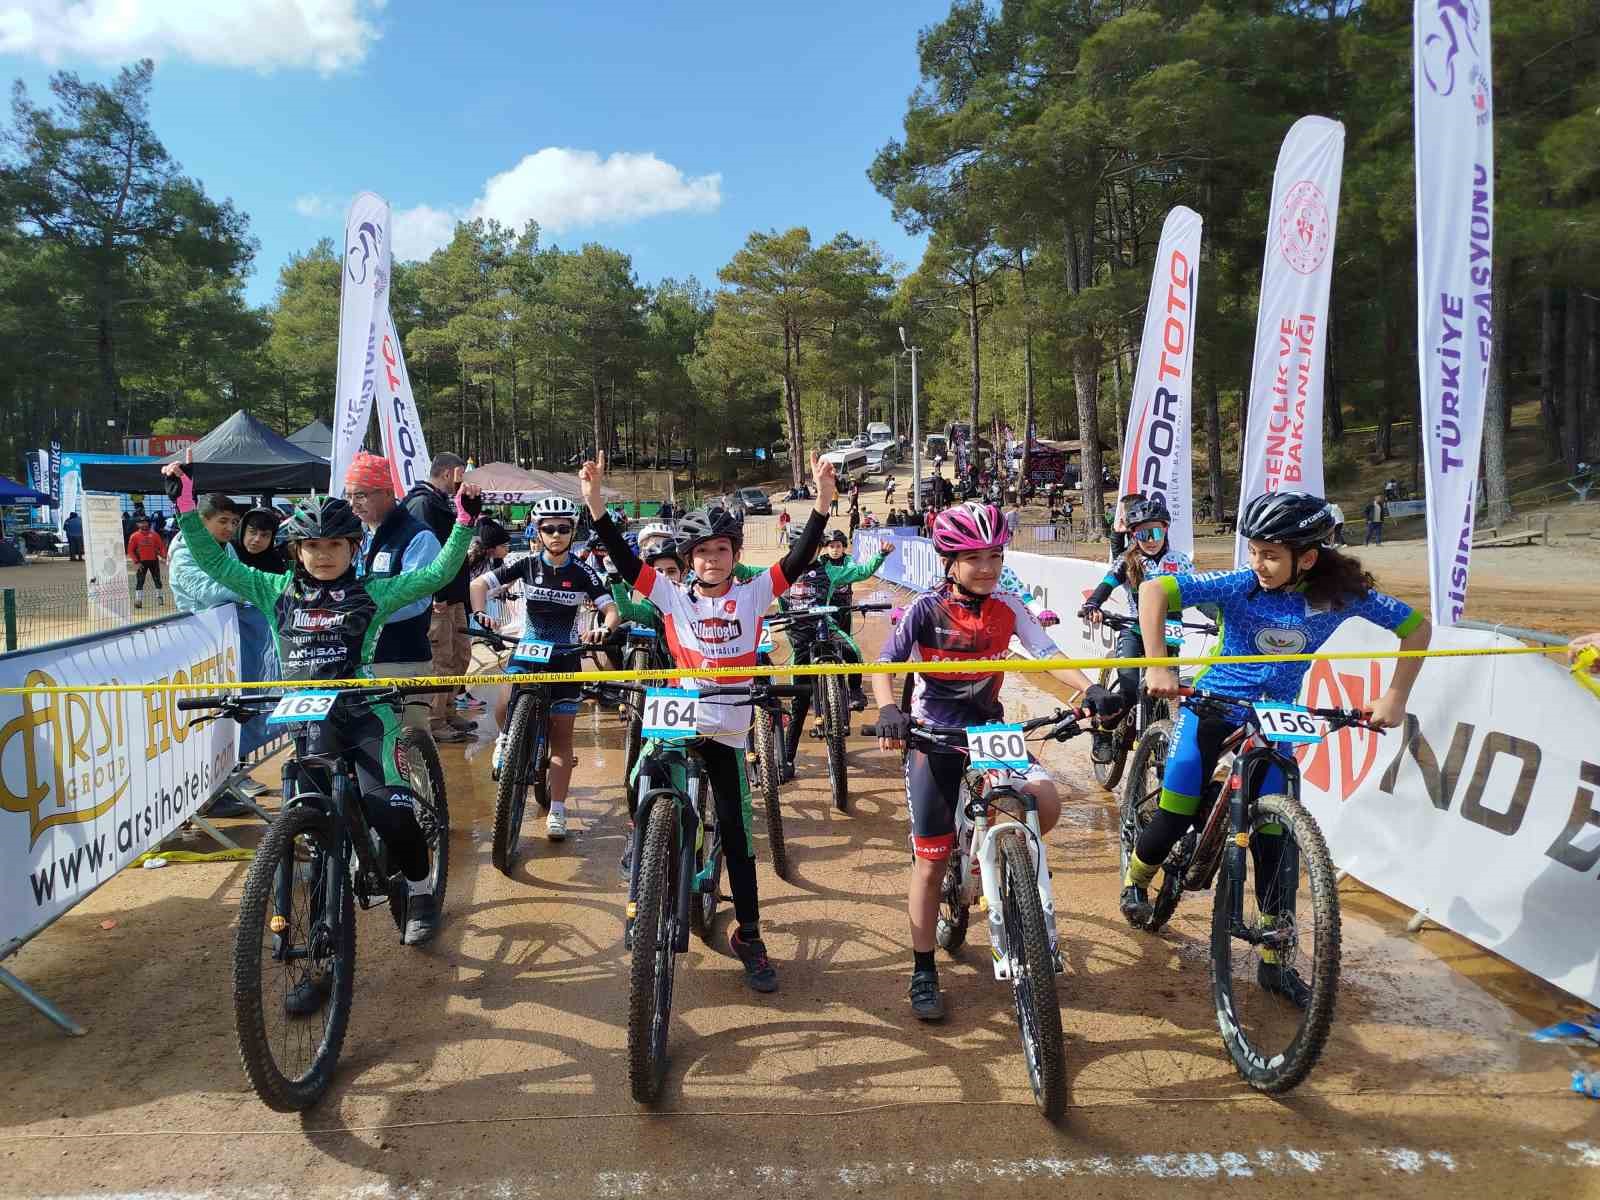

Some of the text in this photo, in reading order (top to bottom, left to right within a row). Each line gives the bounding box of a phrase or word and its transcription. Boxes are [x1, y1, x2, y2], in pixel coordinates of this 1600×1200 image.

[1157, 249, 1188, 382] TOTO
[1279, 318, 1296, 357] VE
[1436, 293, 1464, 473] TÜRKİYE
[519, 643, 550, 659] 161
[550, 672, 575, 681] ENTER
[279, 697, 331, 715] 163
[647, 699, 697, 727] 164
[1262, 710, 1316, 734] 156
[972, 734, 1025, 760] 160
[66, 755, 127, 802] GROUP
[1379, 711, 1543, 837] NO
